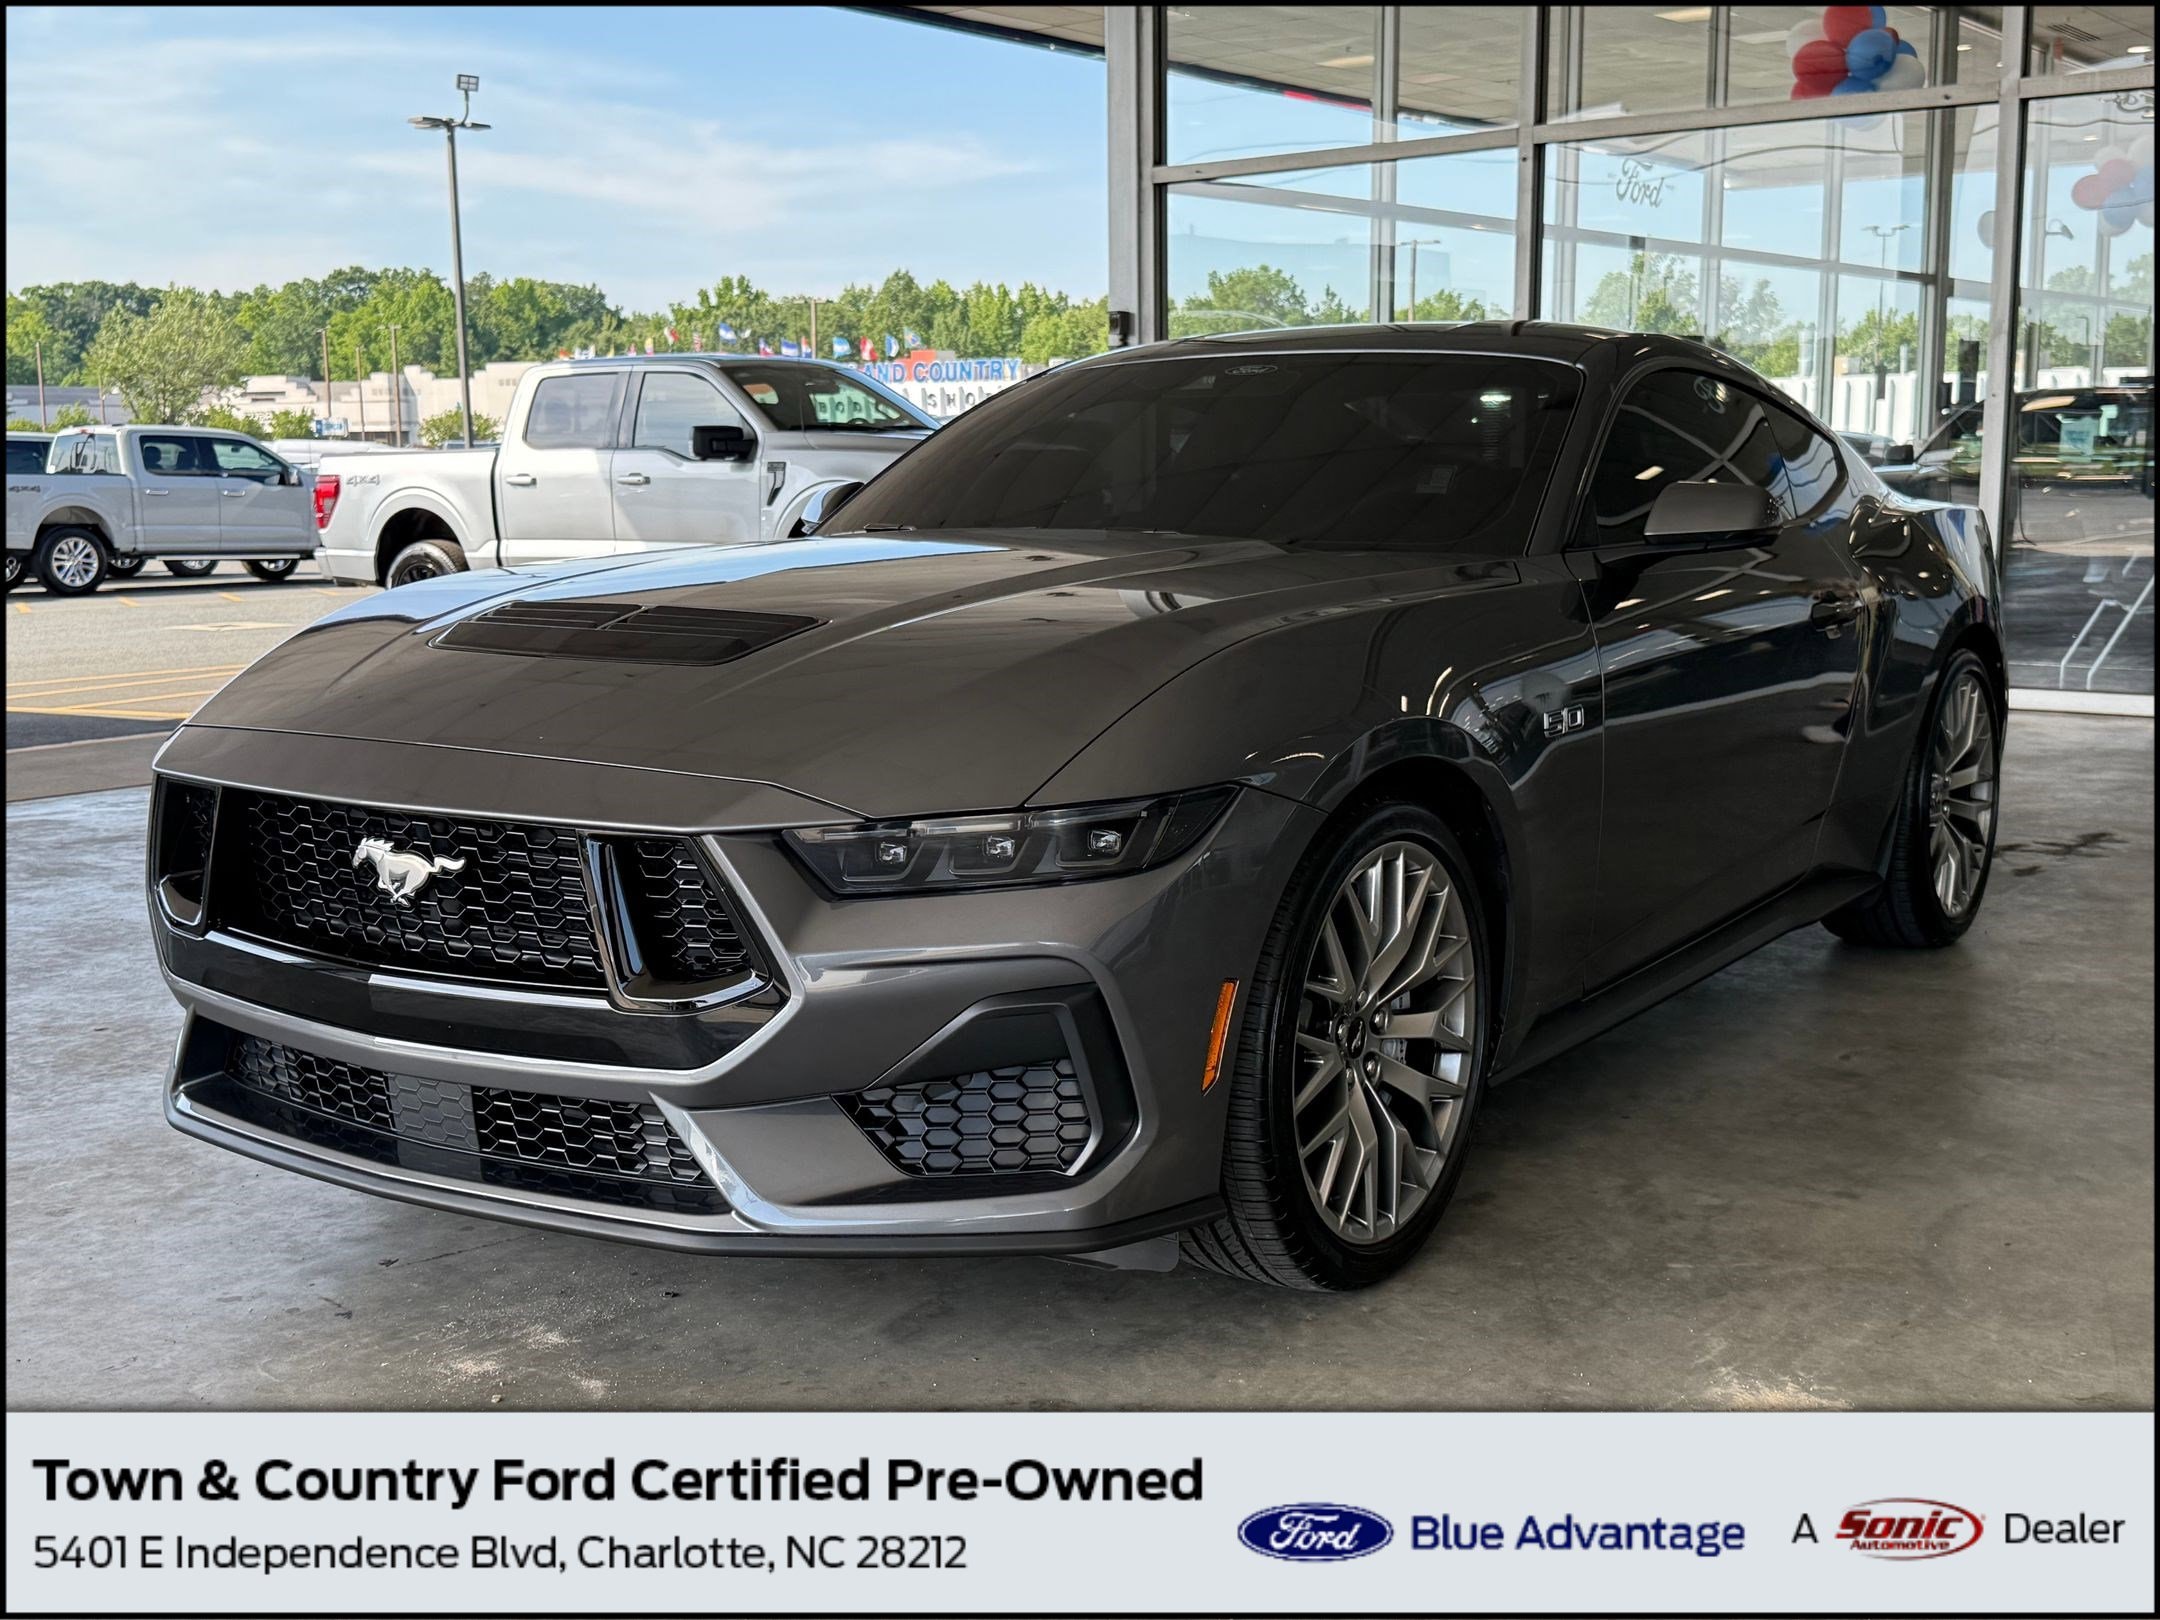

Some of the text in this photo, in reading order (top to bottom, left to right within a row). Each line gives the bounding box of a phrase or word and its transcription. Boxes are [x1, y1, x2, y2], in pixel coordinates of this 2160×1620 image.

[1616, 157, 1664, 208] Ford
[913, 359, 1021, 384] COUNTRY
[927, 392, 991, 408] SHO
